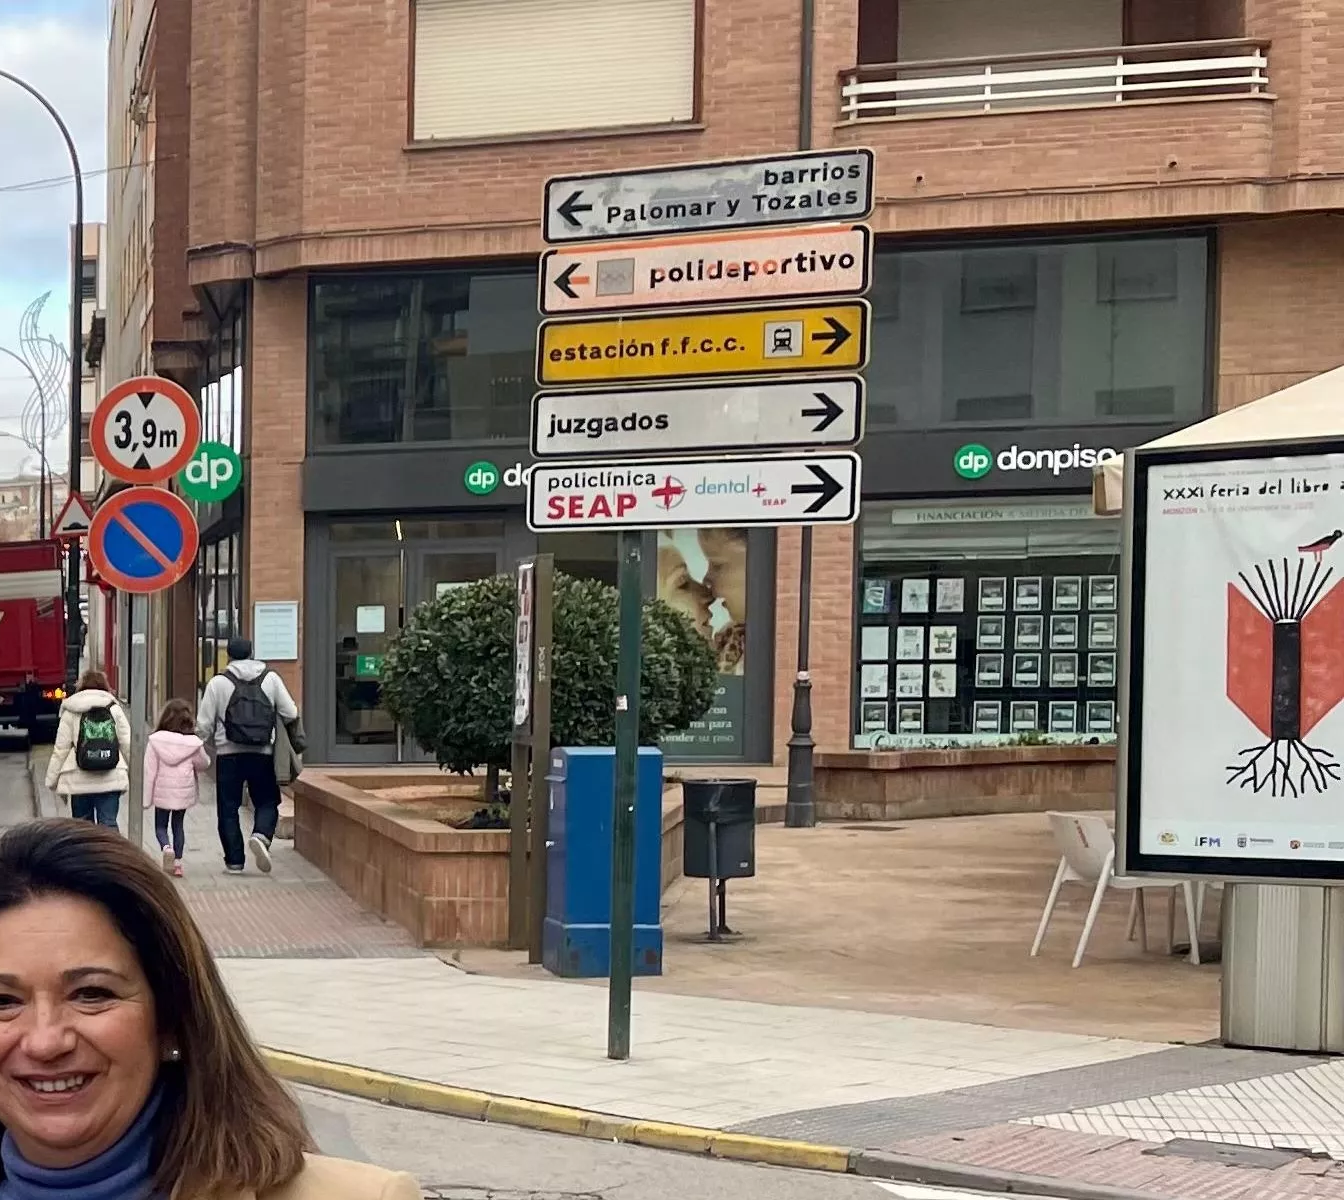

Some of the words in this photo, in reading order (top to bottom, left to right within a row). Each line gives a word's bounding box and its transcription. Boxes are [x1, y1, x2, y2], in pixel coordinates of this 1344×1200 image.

[764, 163, 861, 186] barrios
[607, 198, 716, 224] Palomar
[726, 198, 740, 217] y
[752, 188, 859, 213] Tozales
[649, 250, 855, 288] polideportivo
[549, 338, 654, 363] estación
[660, 333, 745, 356] f.f.c.c.
[547, 412, 669, 438] juzgados
[185, 452, 233, 489] dp
[960, 451, 987, 472] dp
[469, 469, 495, 489] dp
[548, 471, 656, 491] policlínica
[695, 476, 750, 495] dental
[1164, 487, 1204, 500] XXXI
[1211, 484, 1250, 498] feria
[1259, 479, 1282, 495] del
[1291, 477, 1330, 494] libro
[547, 494, 637, 519] SEAP
